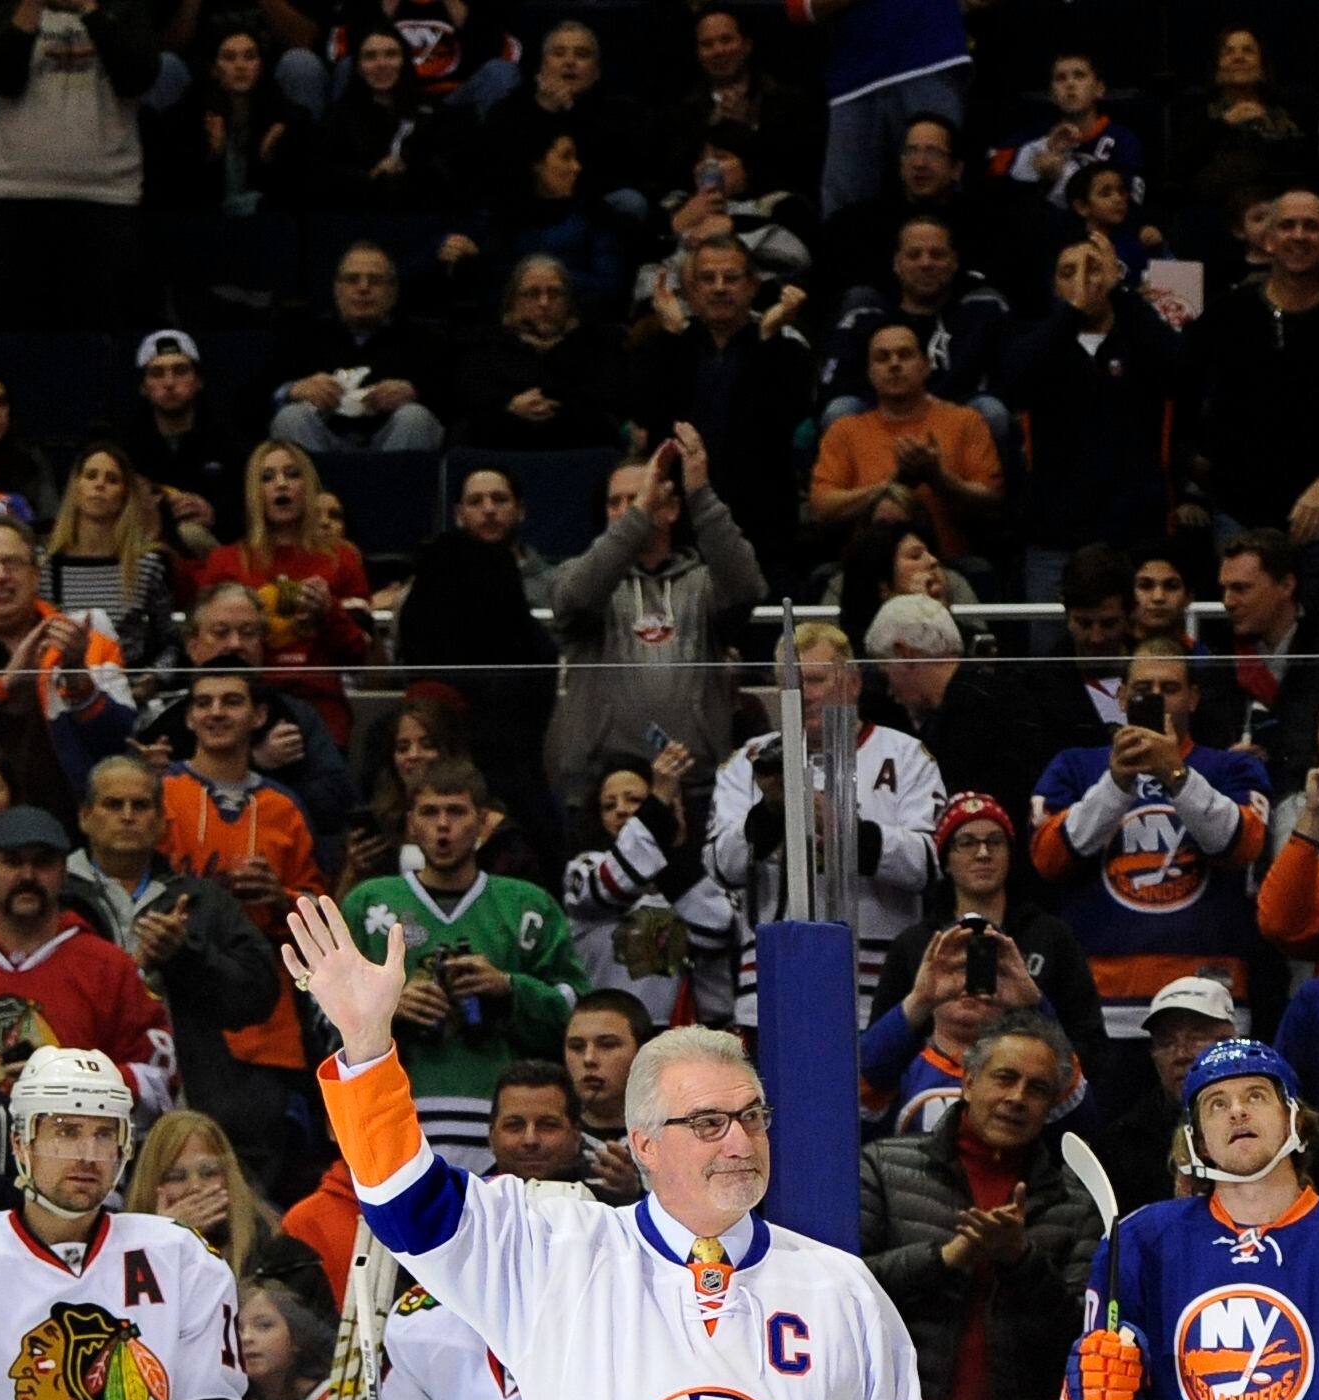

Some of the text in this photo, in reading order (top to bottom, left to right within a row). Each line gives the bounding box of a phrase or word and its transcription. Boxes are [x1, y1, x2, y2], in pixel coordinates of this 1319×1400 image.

[874, 759, 897, 793] A
[1124, 812, 1186, 853] NY
[519, 910, 543, 952] C
[75, 1059, 100, 1073] 10
[124, 1248, 165, 1307] A
[221, 1303, 248, 1373] 1
[767, 1310, 812, 1377] C
[1200, 1297, 1281, 1350] NY
